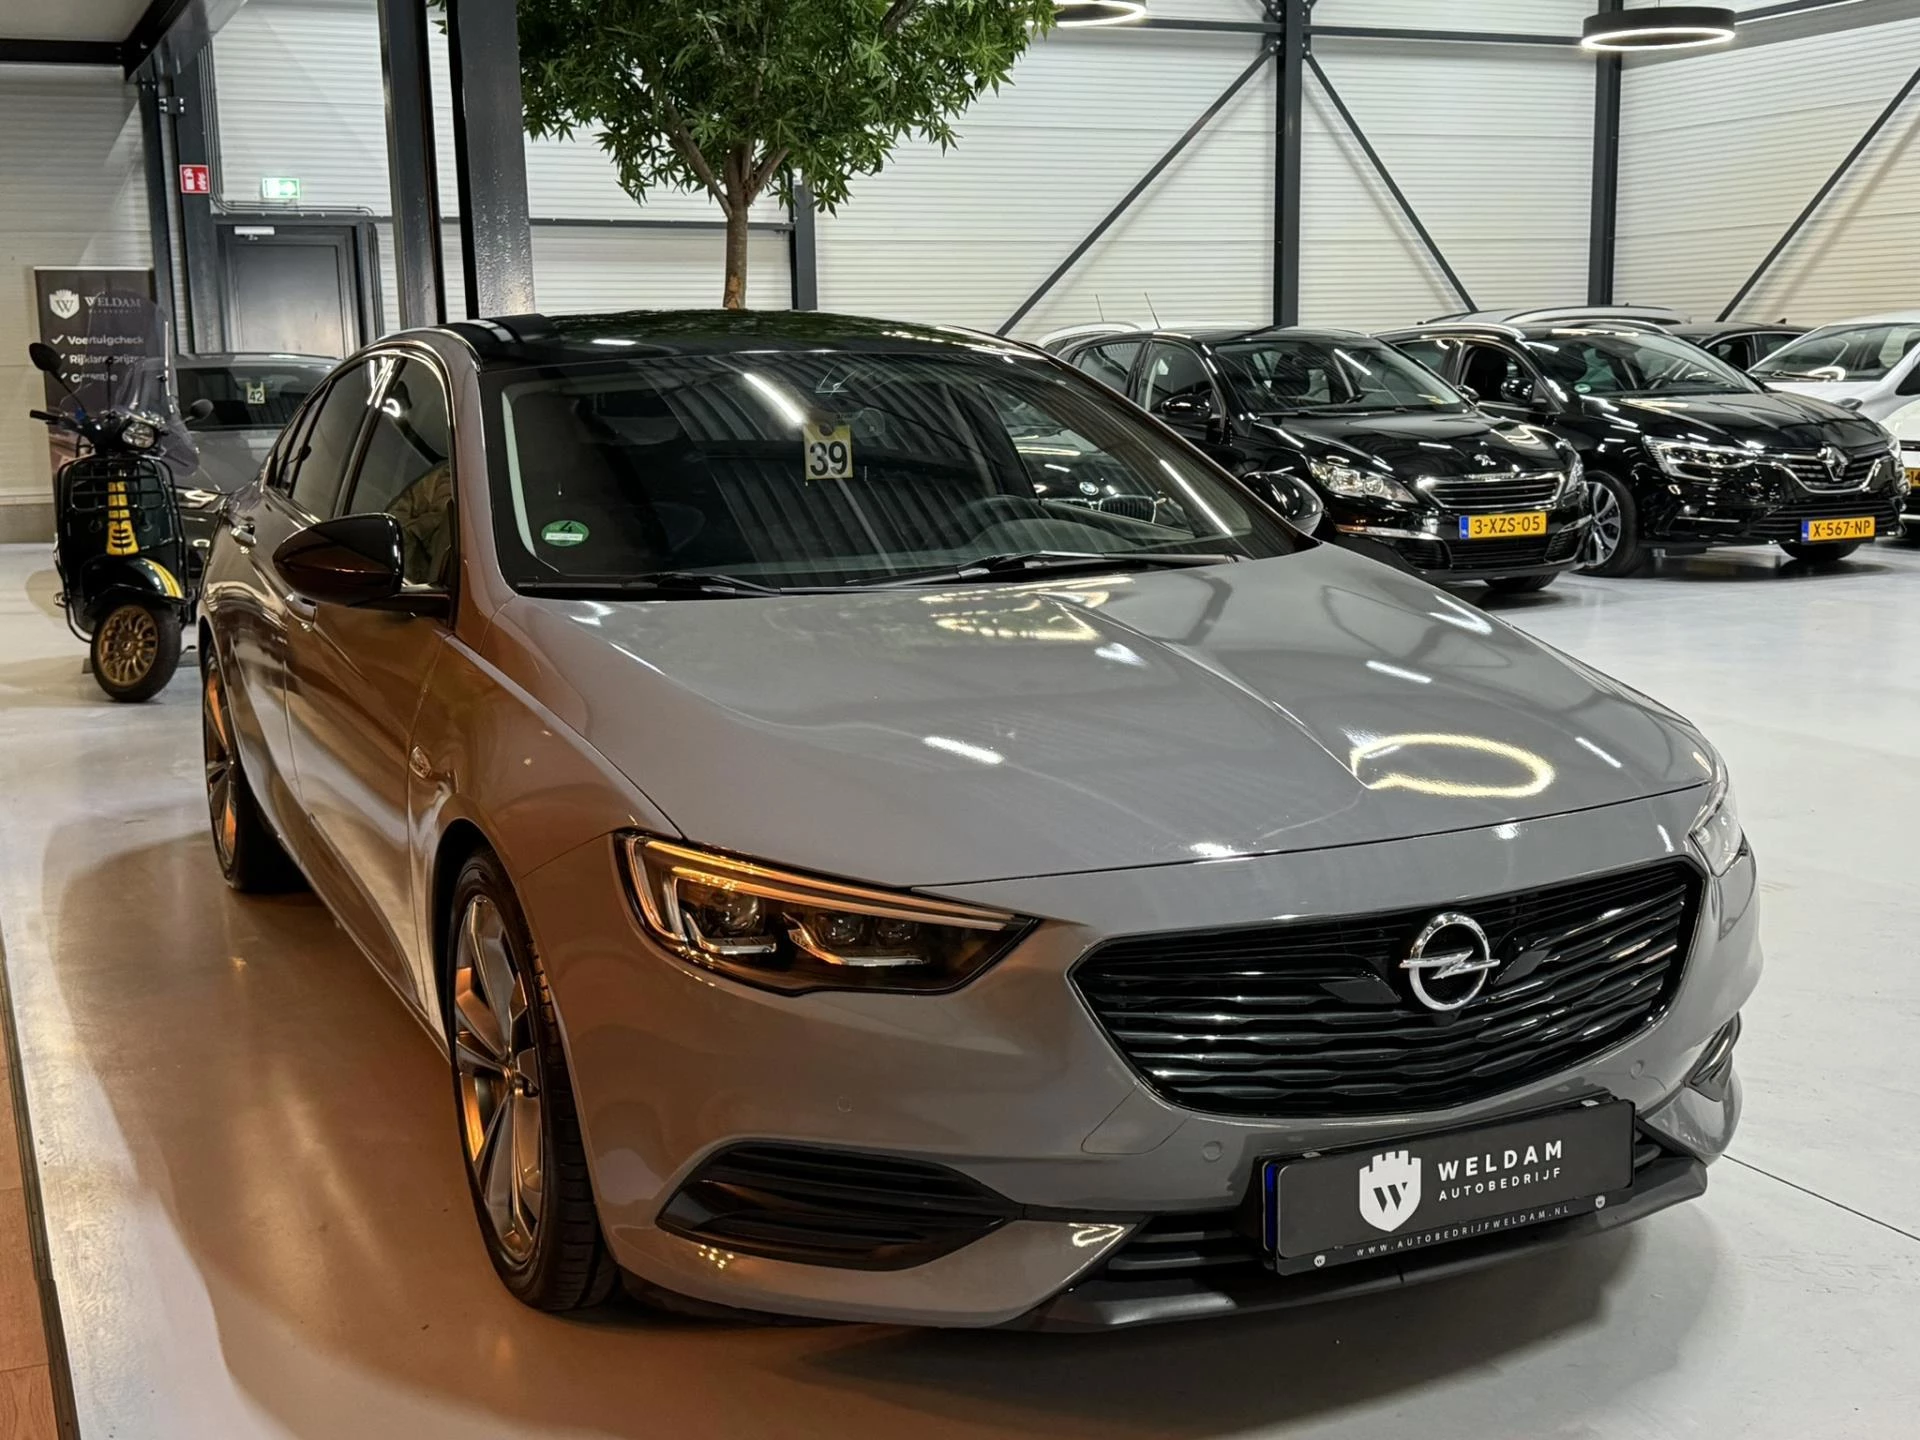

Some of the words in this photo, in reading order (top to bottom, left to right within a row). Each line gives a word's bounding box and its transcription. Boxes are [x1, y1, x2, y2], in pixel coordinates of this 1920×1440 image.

[55, 299, 74, 313] W
[84, 296, 141, 307] WELDAM
[249, 391, 263, 402] 42
[810, 441, 848, 476] 39
[560, 521, 572, 533] 4
[1474, 516, 1540, 535] 3-XZS-05
[1813, 520, 1871, 537] X-567-NP
[1438, 1140, 1562, 1182] WELDAM
[1438, 1167, 1561, 1202] AUTOBEDRIJF
[1373, 1181, 1408, 1213] W
[1356, 1205, 1569, 1256] WWW.AUTOBEDRIJFWELDAM.NL
